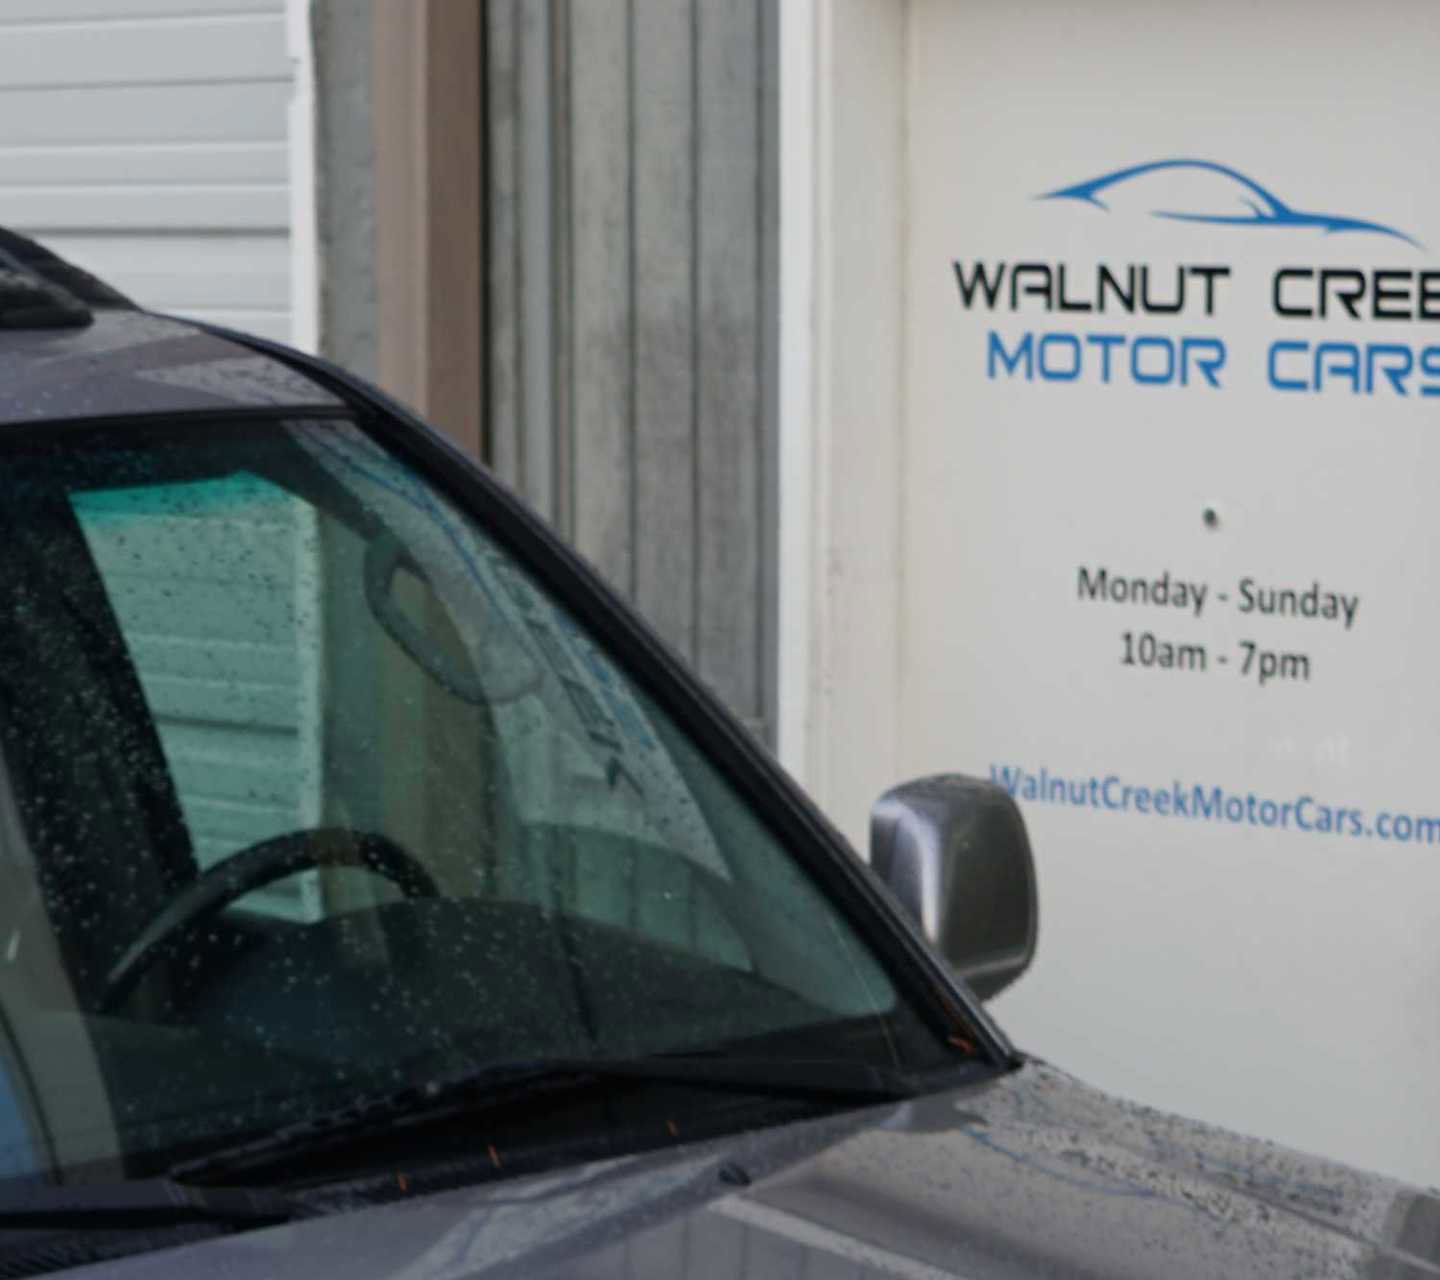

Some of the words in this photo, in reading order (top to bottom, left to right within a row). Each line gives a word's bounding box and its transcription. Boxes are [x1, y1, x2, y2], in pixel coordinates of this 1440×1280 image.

[952, 261, 1231, 315] WALNUT
[988, 331, 1228, 388] MOTOR
[1077, 567, 1208, 617] Monday
[1238, 580, 1359, 629] Sunday
[1120, 632, 1207, 672] 10am
[1239, 641, 1310, 685] 7pm
